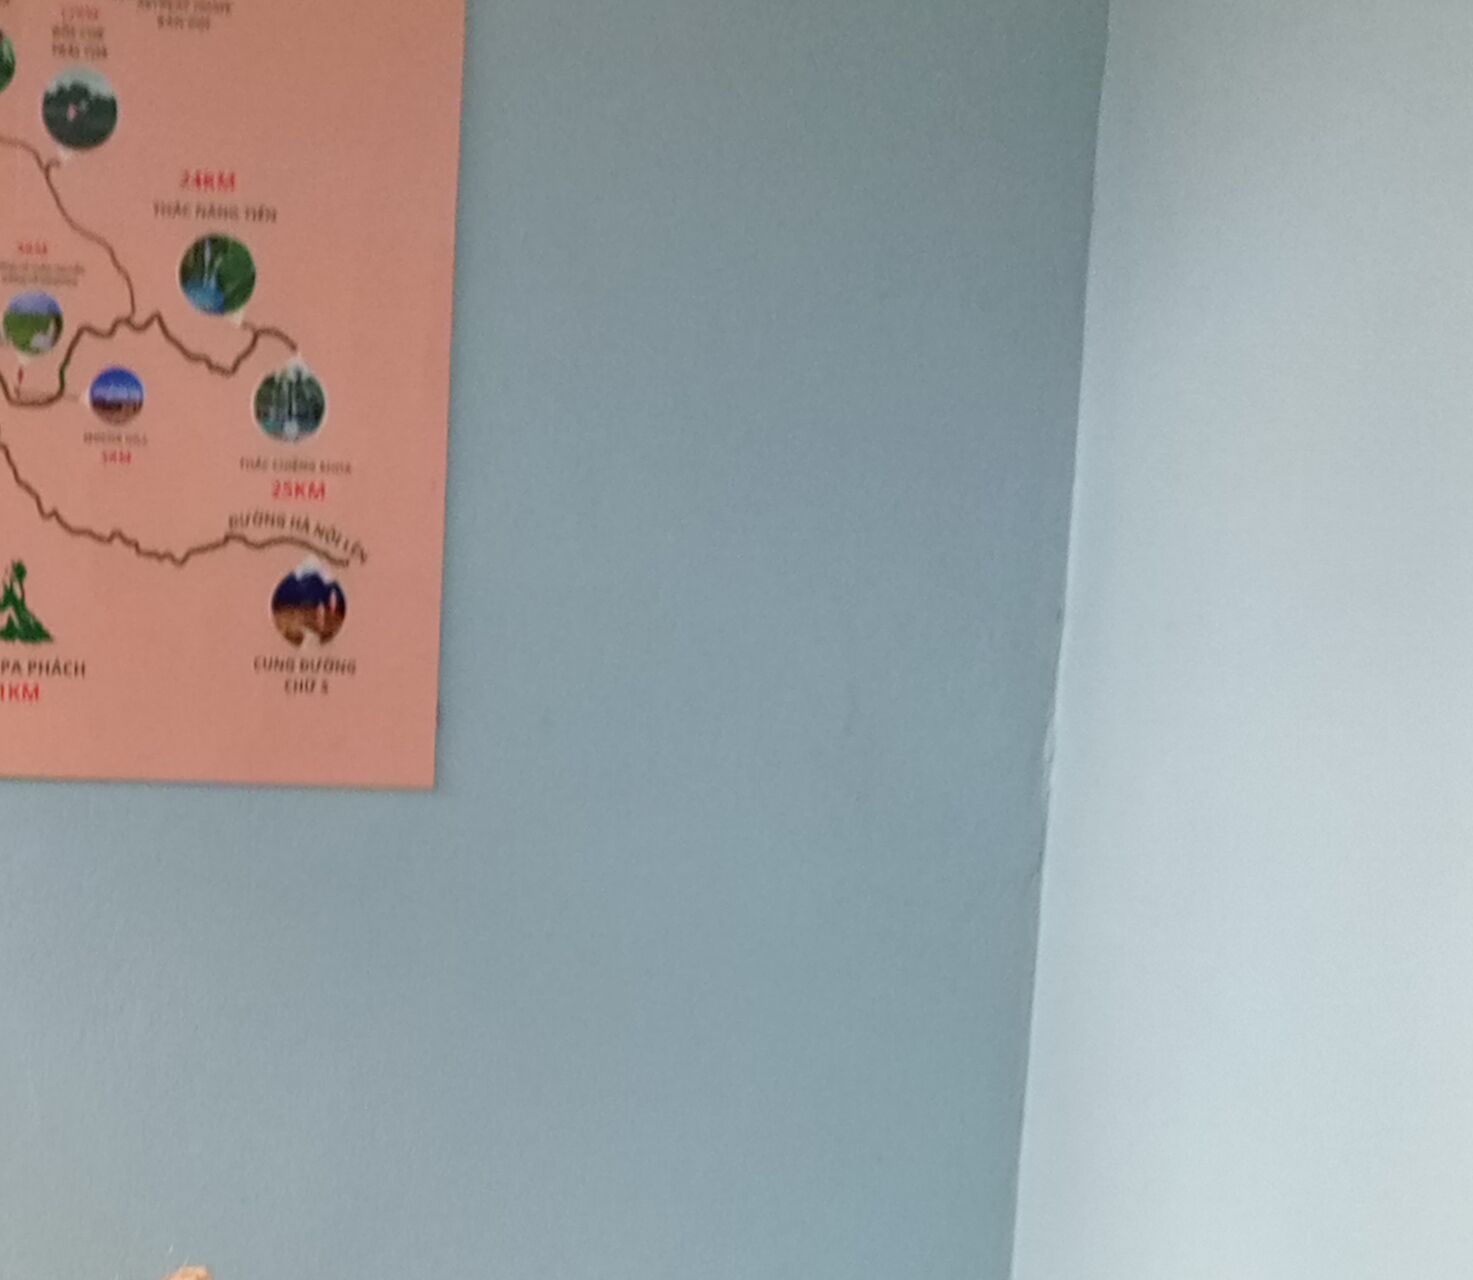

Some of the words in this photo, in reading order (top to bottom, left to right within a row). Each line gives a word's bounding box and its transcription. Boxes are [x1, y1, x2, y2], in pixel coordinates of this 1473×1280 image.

[272, 480, 326, 502] 25KM
[228, 510, 286, 532] ĐƯỜNG
[289, 513, 310, 534] HÀ
[0, 656, 22, 675] PA
[27, 653, 86, 678] PHÁCH
[253, 654, 295, 674] CUNG
[297, 653, 357, 677] ĐƯỜNG
